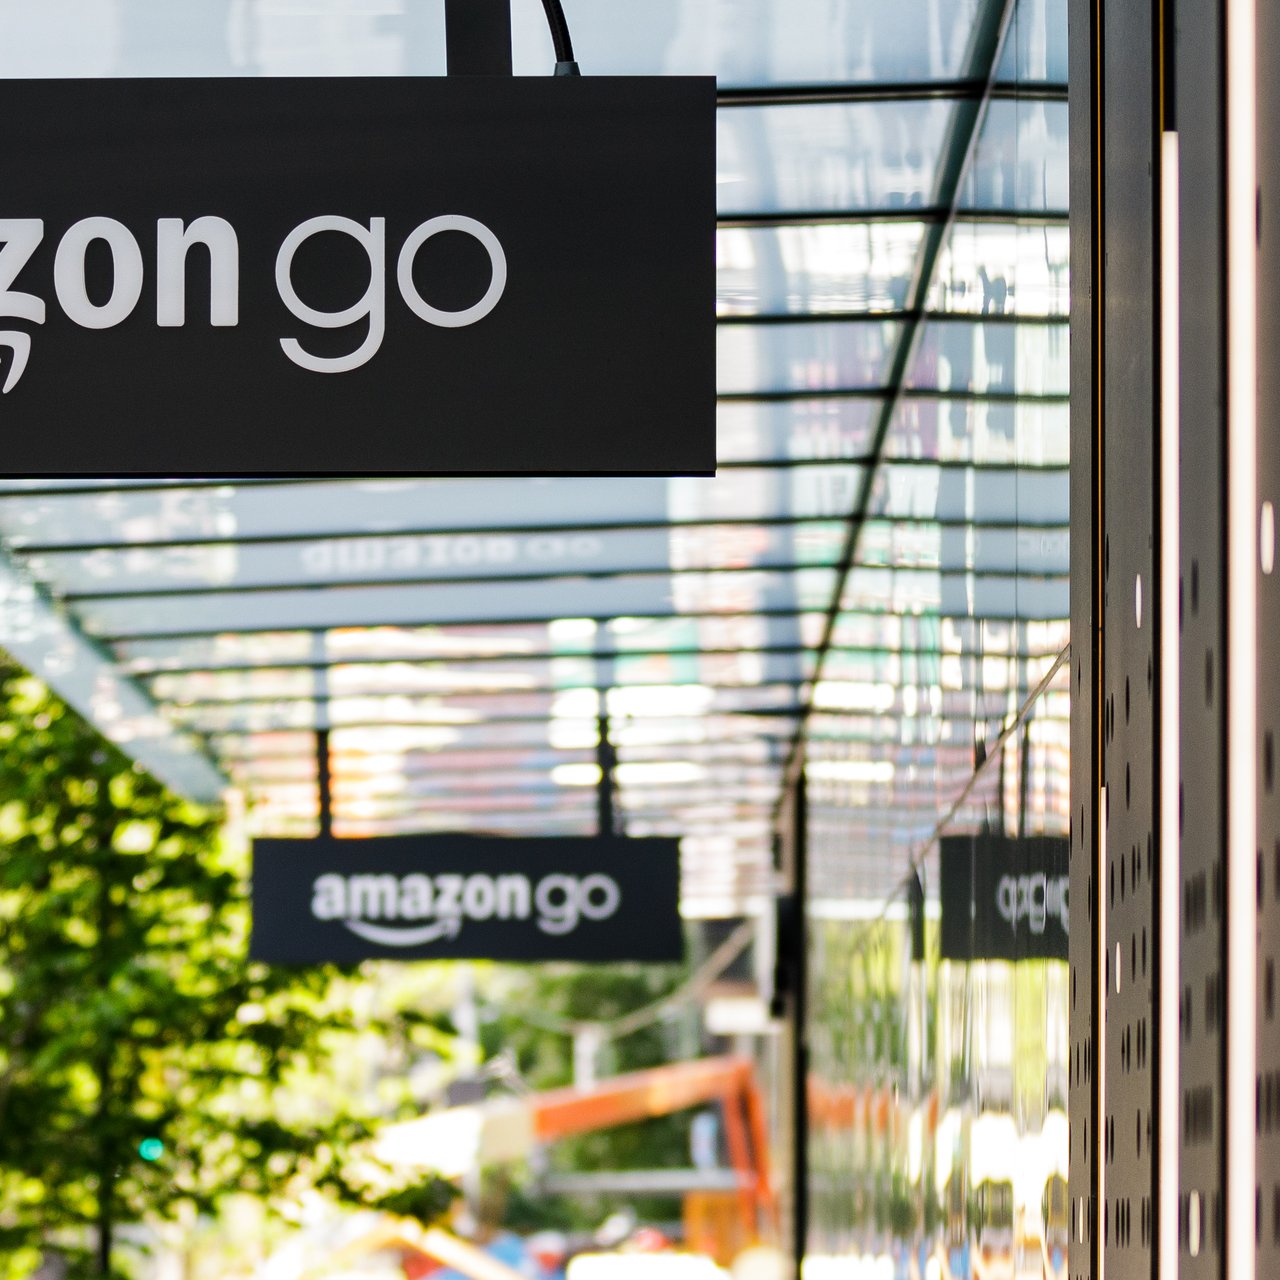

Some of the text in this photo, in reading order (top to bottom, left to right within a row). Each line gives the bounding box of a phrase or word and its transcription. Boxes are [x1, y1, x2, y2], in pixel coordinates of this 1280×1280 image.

[274, 214, 508, 374] go
[310, 872, 622, 936] amazon go
